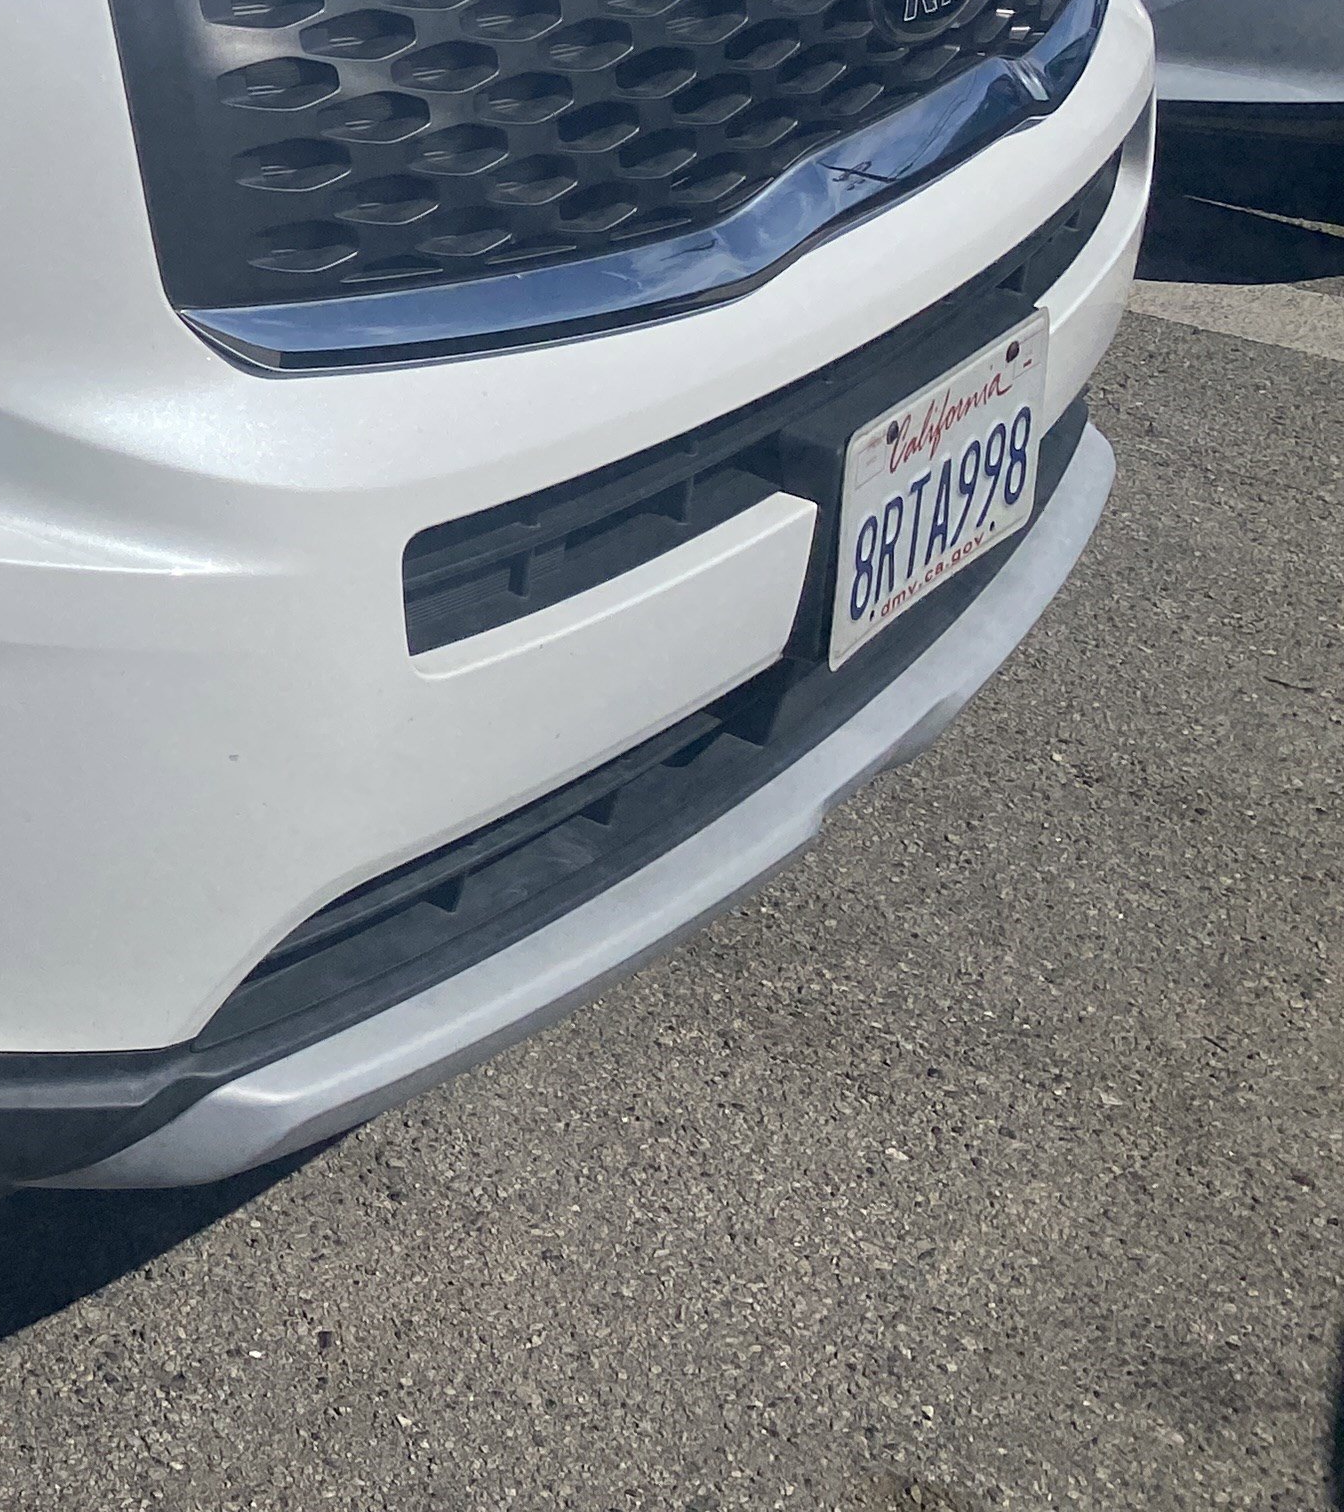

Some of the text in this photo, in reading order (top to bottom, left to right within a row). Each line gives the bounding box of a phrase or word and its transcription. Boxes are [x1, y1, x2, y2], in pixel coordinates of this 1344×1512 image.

[889, 367, 1013, 474] California
[850, 406, 1031, 620] 8RTA998
[881, 535, 985, 617] dmv.ca.gov
